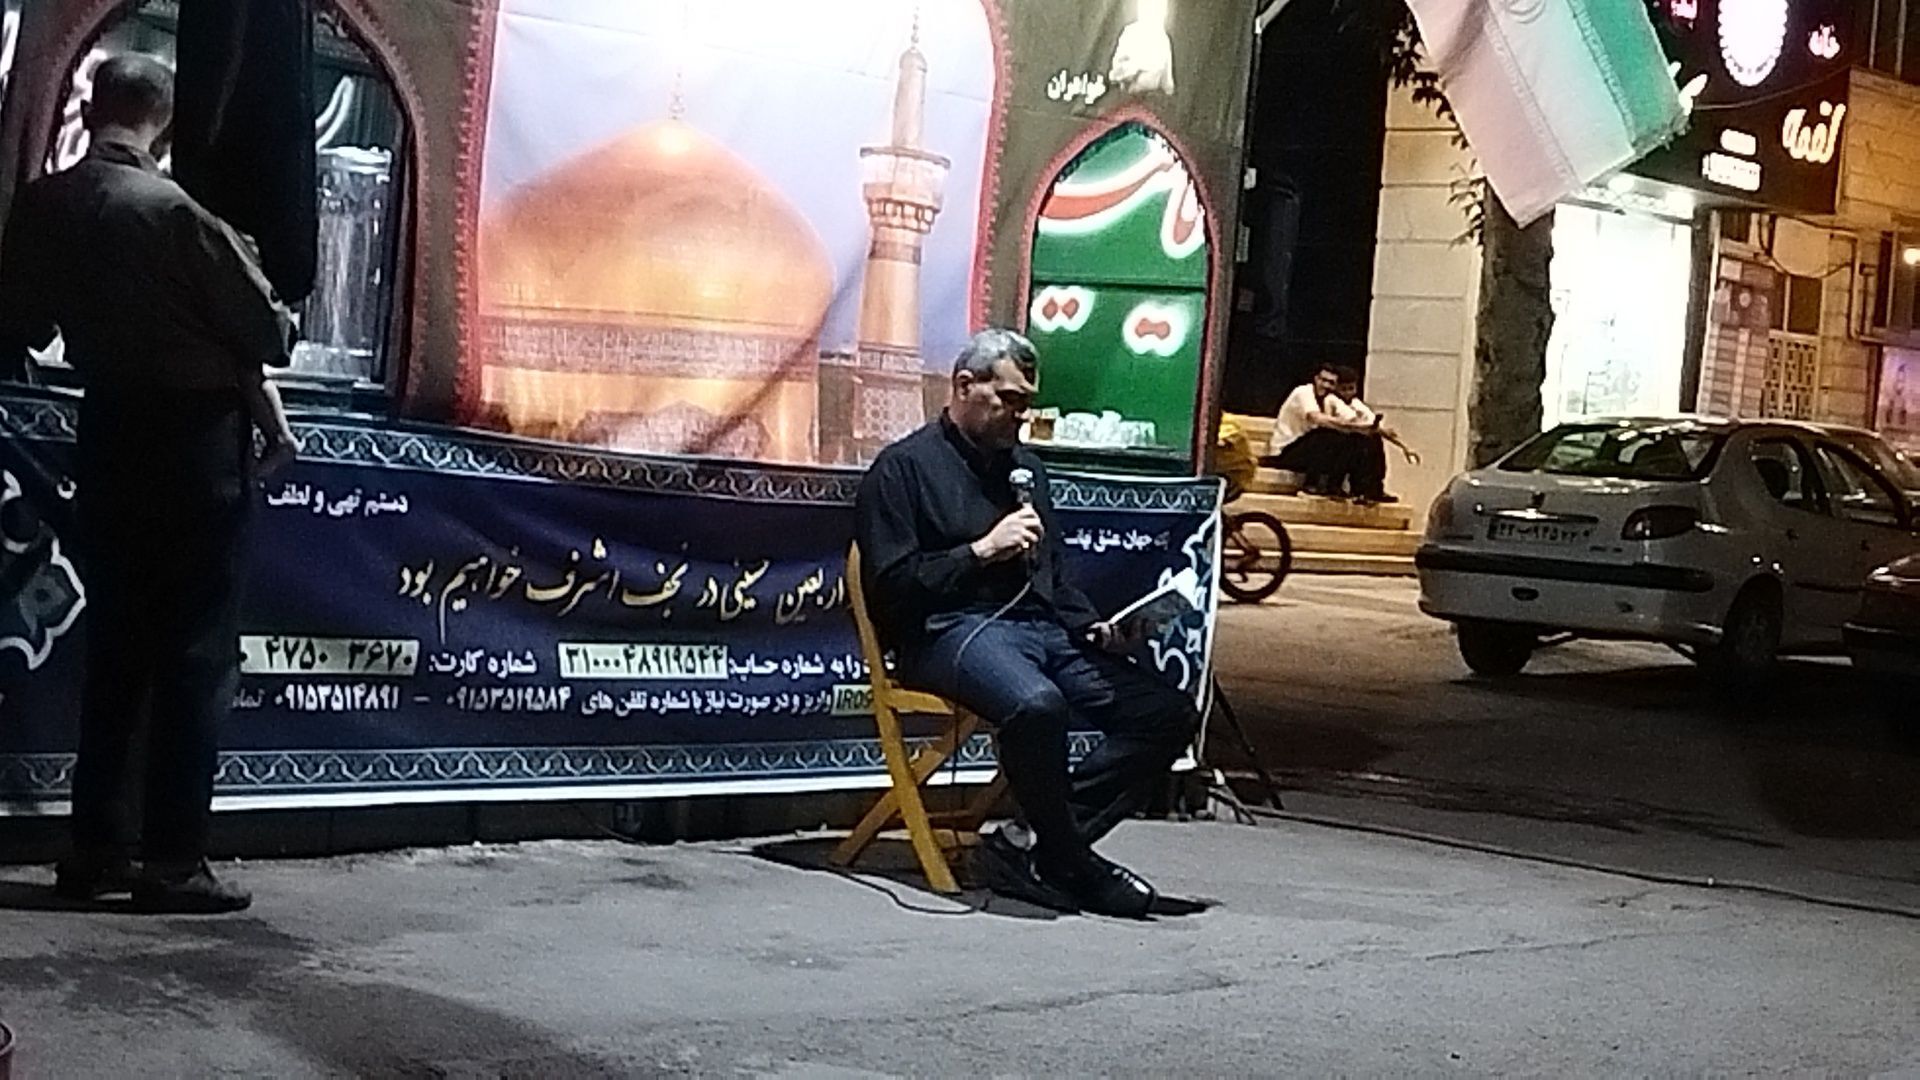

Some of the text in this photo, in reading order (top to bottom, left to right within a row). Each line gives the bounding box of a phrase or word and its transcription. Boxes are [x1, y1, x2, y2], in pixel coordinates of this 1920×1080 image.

[1047, 69, 1106, 104] خواهران
[266, 482, 311, 507] لطف
[312, 489, 325, 514] و
[397, 558, 434, 604] بود
[487, 649, 538, 679] شماره
[780, 652, 826, 681] شماره
[649, 687, 692, 713] شماره
[726, 690, 771, 717] صورت
